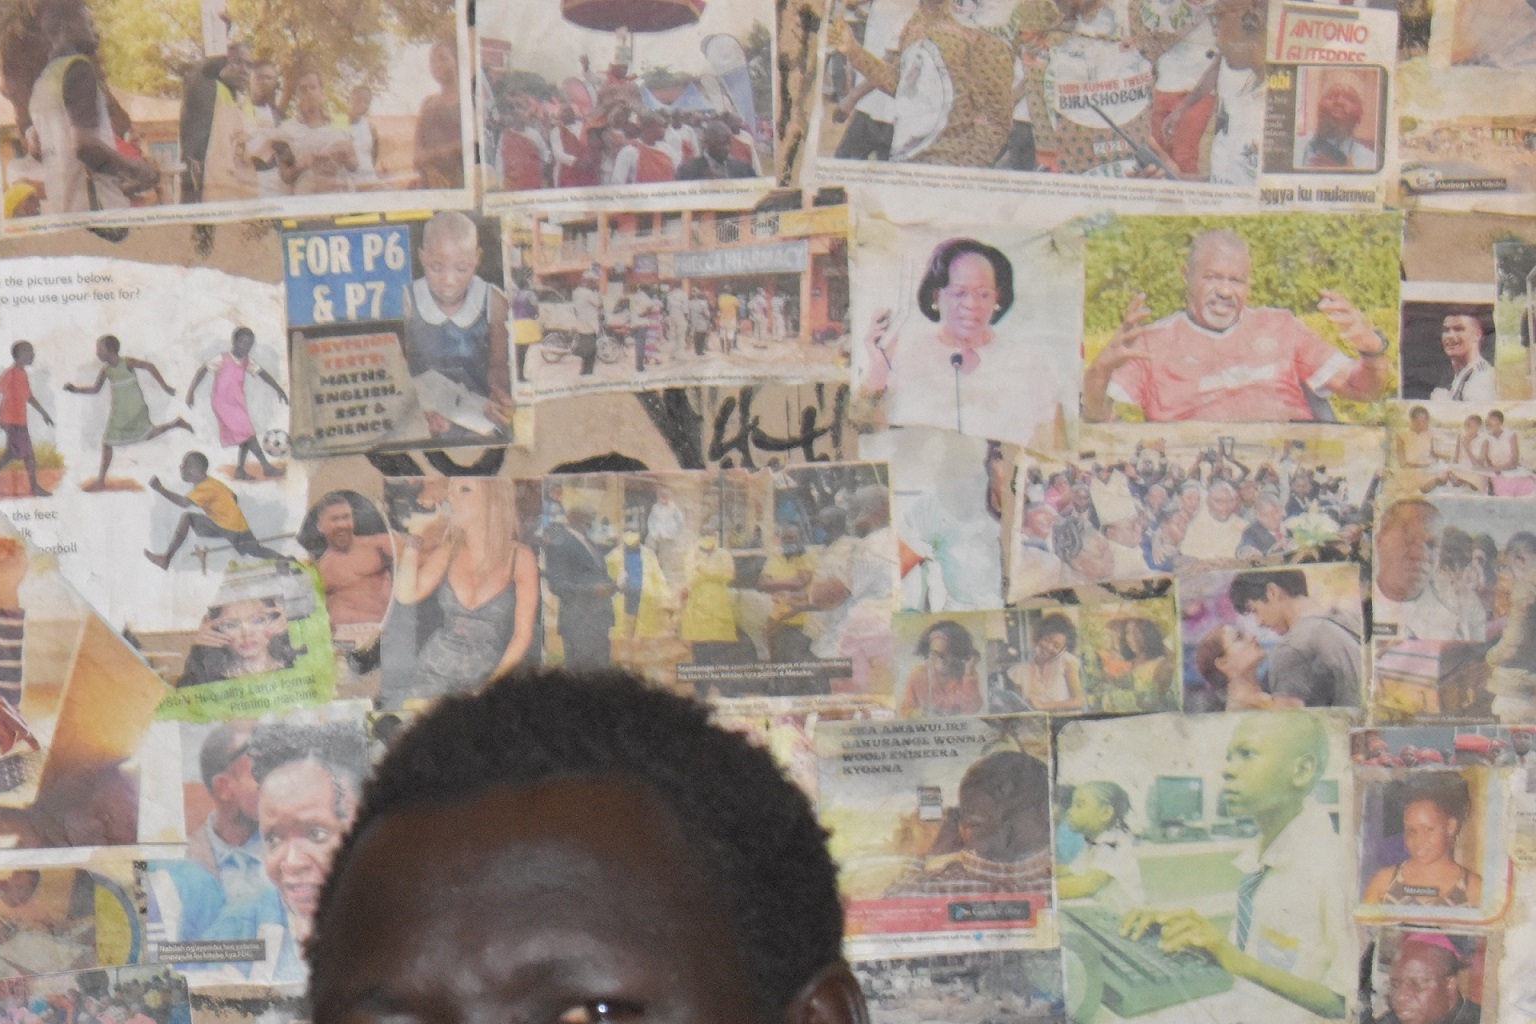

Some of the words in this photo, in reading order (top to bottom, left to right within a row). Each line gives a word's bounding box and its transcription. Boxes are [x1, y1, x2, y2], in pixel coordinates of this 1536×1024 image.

[1289, 19, 1369, 44] ANTONIO
[1297, 185, 1313, 201] ku
[287, 235, 353, 277] FOR
[361, 231, 405, 272] P6
[5, 276, 23, 287] the
[27, 275, 73, 289] pictures
[77, 273, 113, 285] below.
[13, 295, 35, 307] you
[38, 294, 58, 303] use
[62, 292, 89, 305] your
[93, 290, 114, 300] feet
[118, 289, 140, 299] for?
[313, 284, 335, 324] &
[344, 281, 386, 321] P7
[12, 510, 30, 521] the
